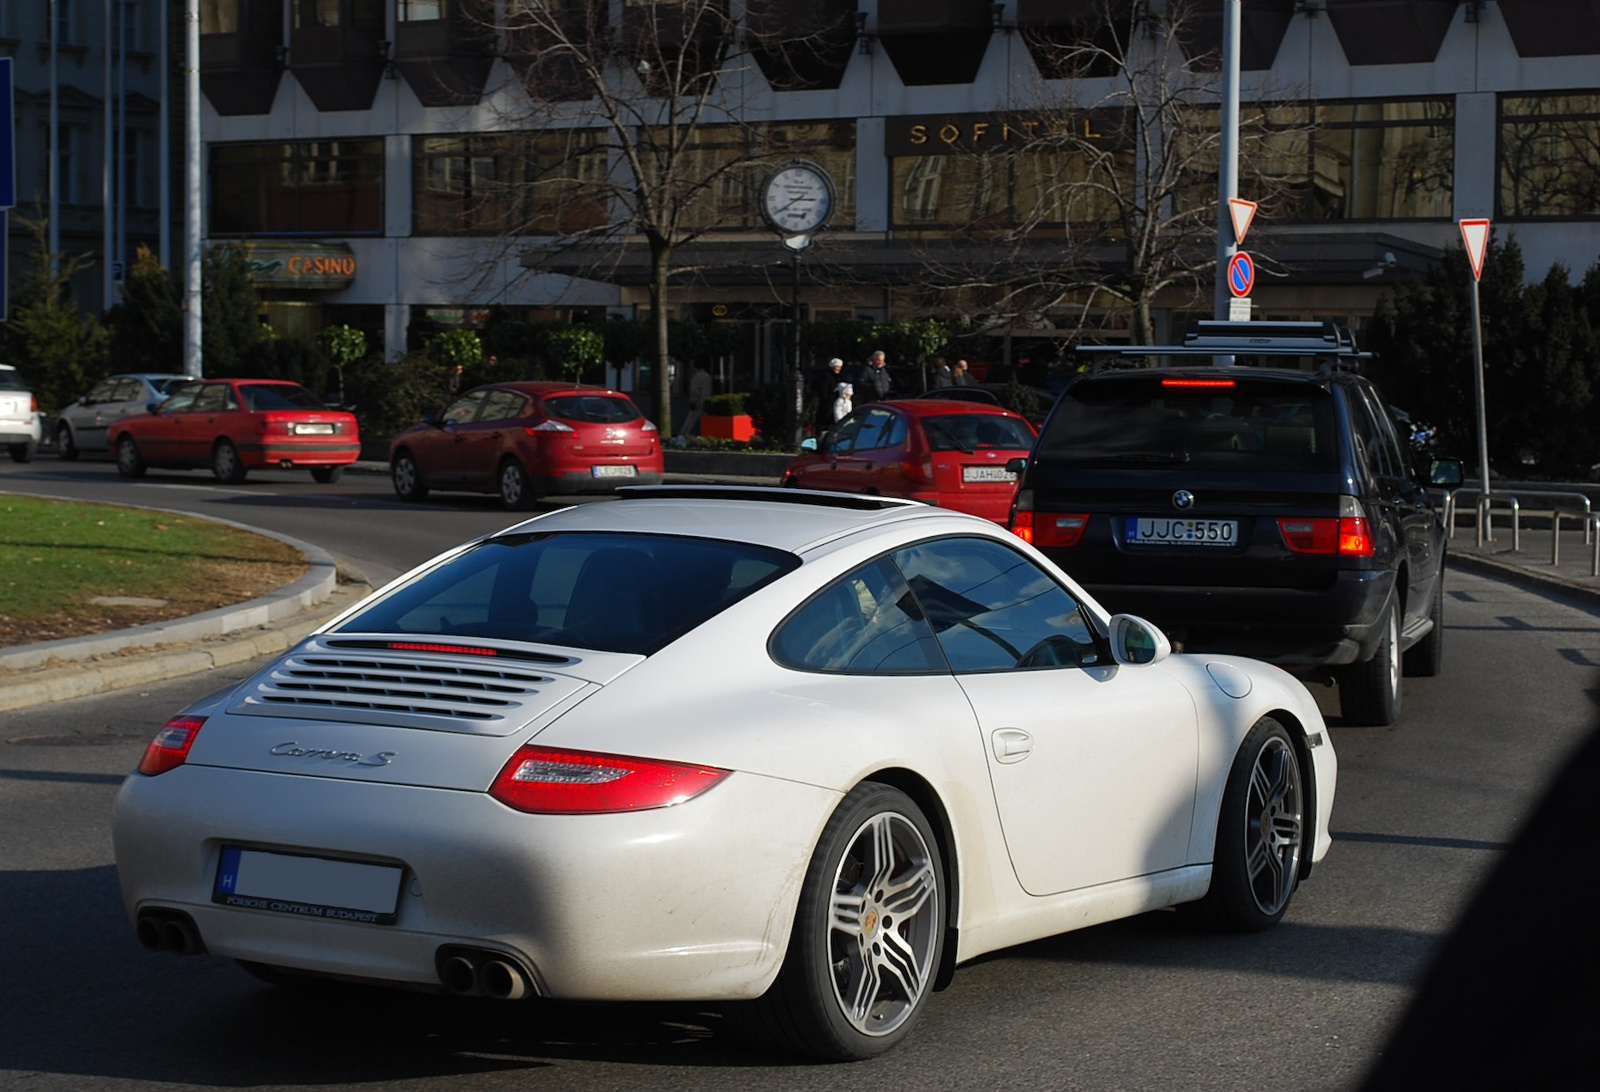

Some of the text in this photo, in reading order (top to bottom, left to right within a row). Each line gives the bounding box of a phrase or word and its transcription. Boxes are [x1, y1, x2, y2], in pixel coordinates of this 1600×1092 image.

[288, 256, 356, 275] CASINO
[270, 741, 399, 767] Carrera S
[222, 875, 233, 888] H
[227, 896, 378, 922] PORSCHE CENTRUM BUDAPEST
